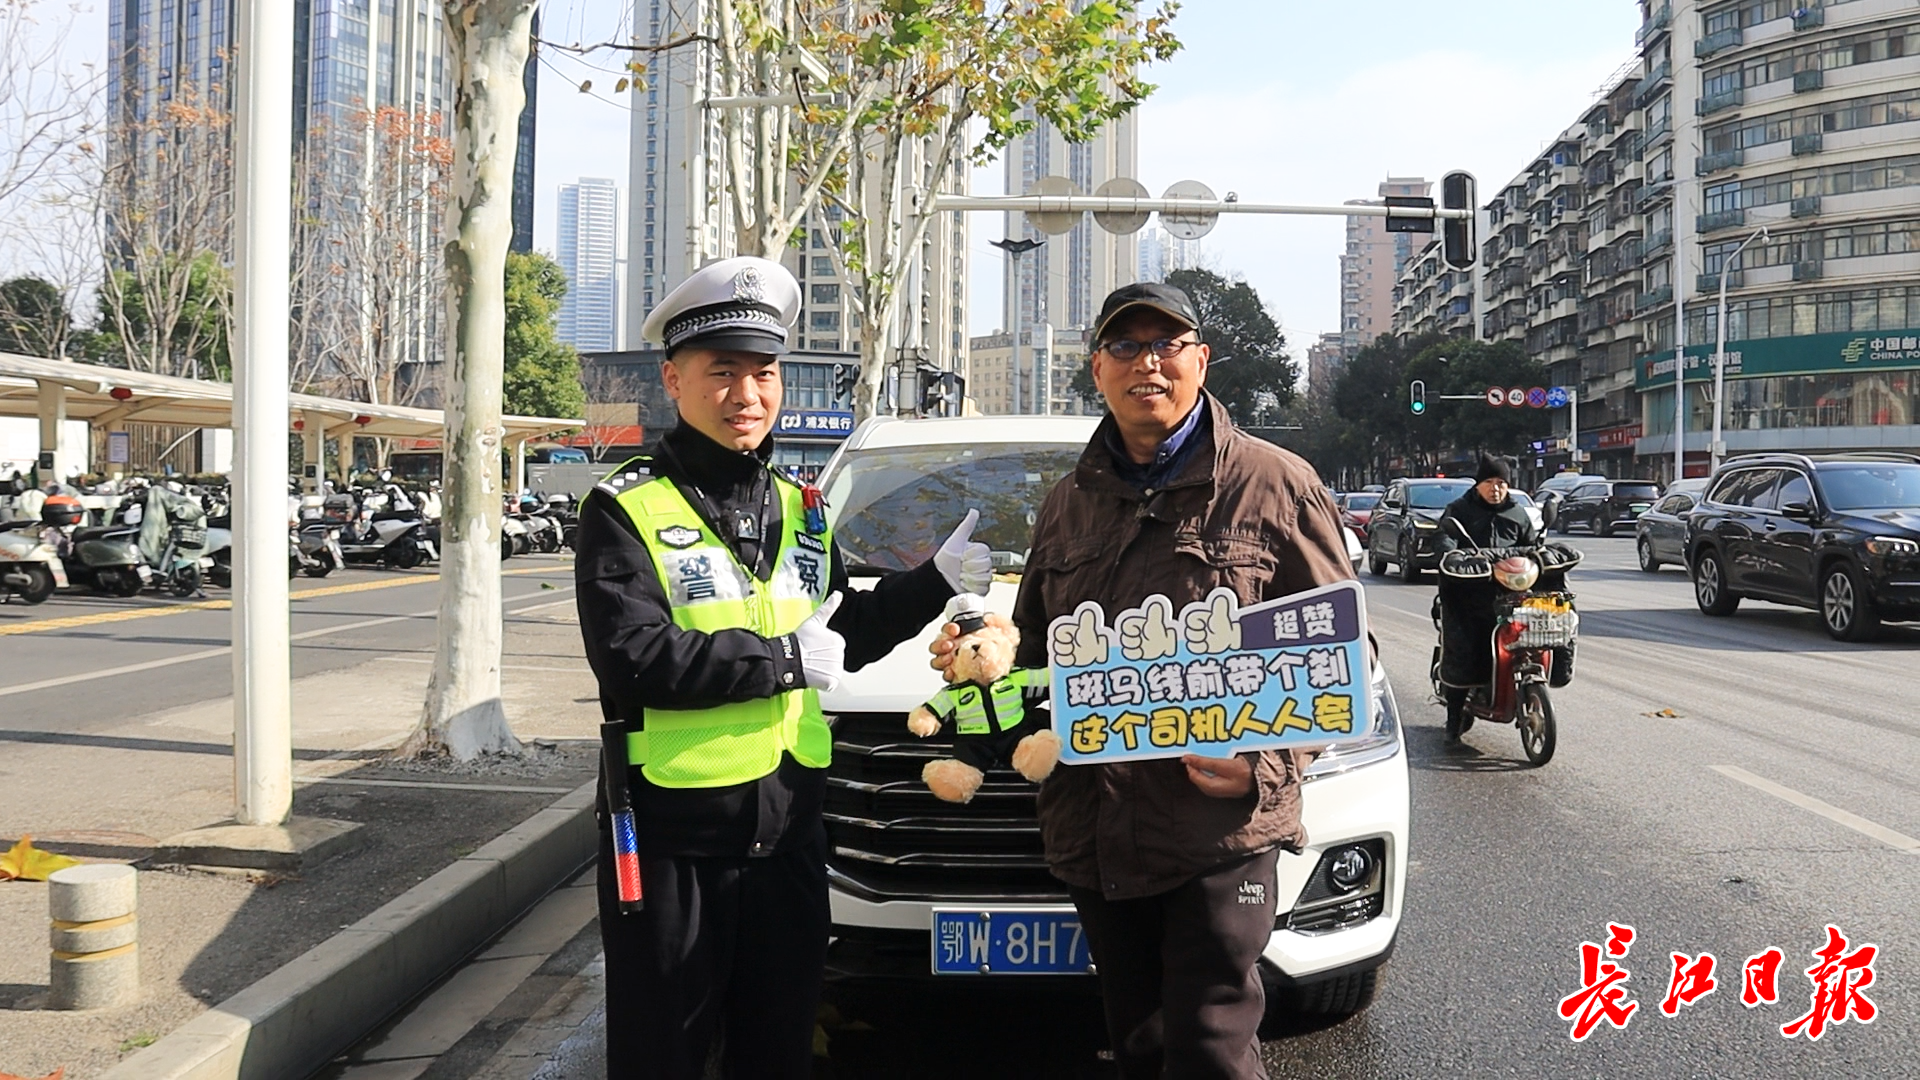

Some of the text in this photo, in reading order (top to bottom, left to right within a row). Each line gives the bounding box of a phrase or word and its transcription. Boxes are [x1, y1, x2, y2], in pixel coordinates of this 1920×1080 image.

[1870, 336, 1920, 352] 中国邮
[1870, 352, 1903, 360] CHINA
[1510, 391, 1522, 402] 40
[805, 416, 852, 430] 浦发银行
[1273, 602, 1336, 642] 超赞
[1066, 646, 1350, 707] 斑马线前带个刹
[1070, 693, 1353, 754] 这个司机人人夸
[1238, 881, 1265, 896] Jeep
[941, 921, 1093, 964] 鄂W·8H7
